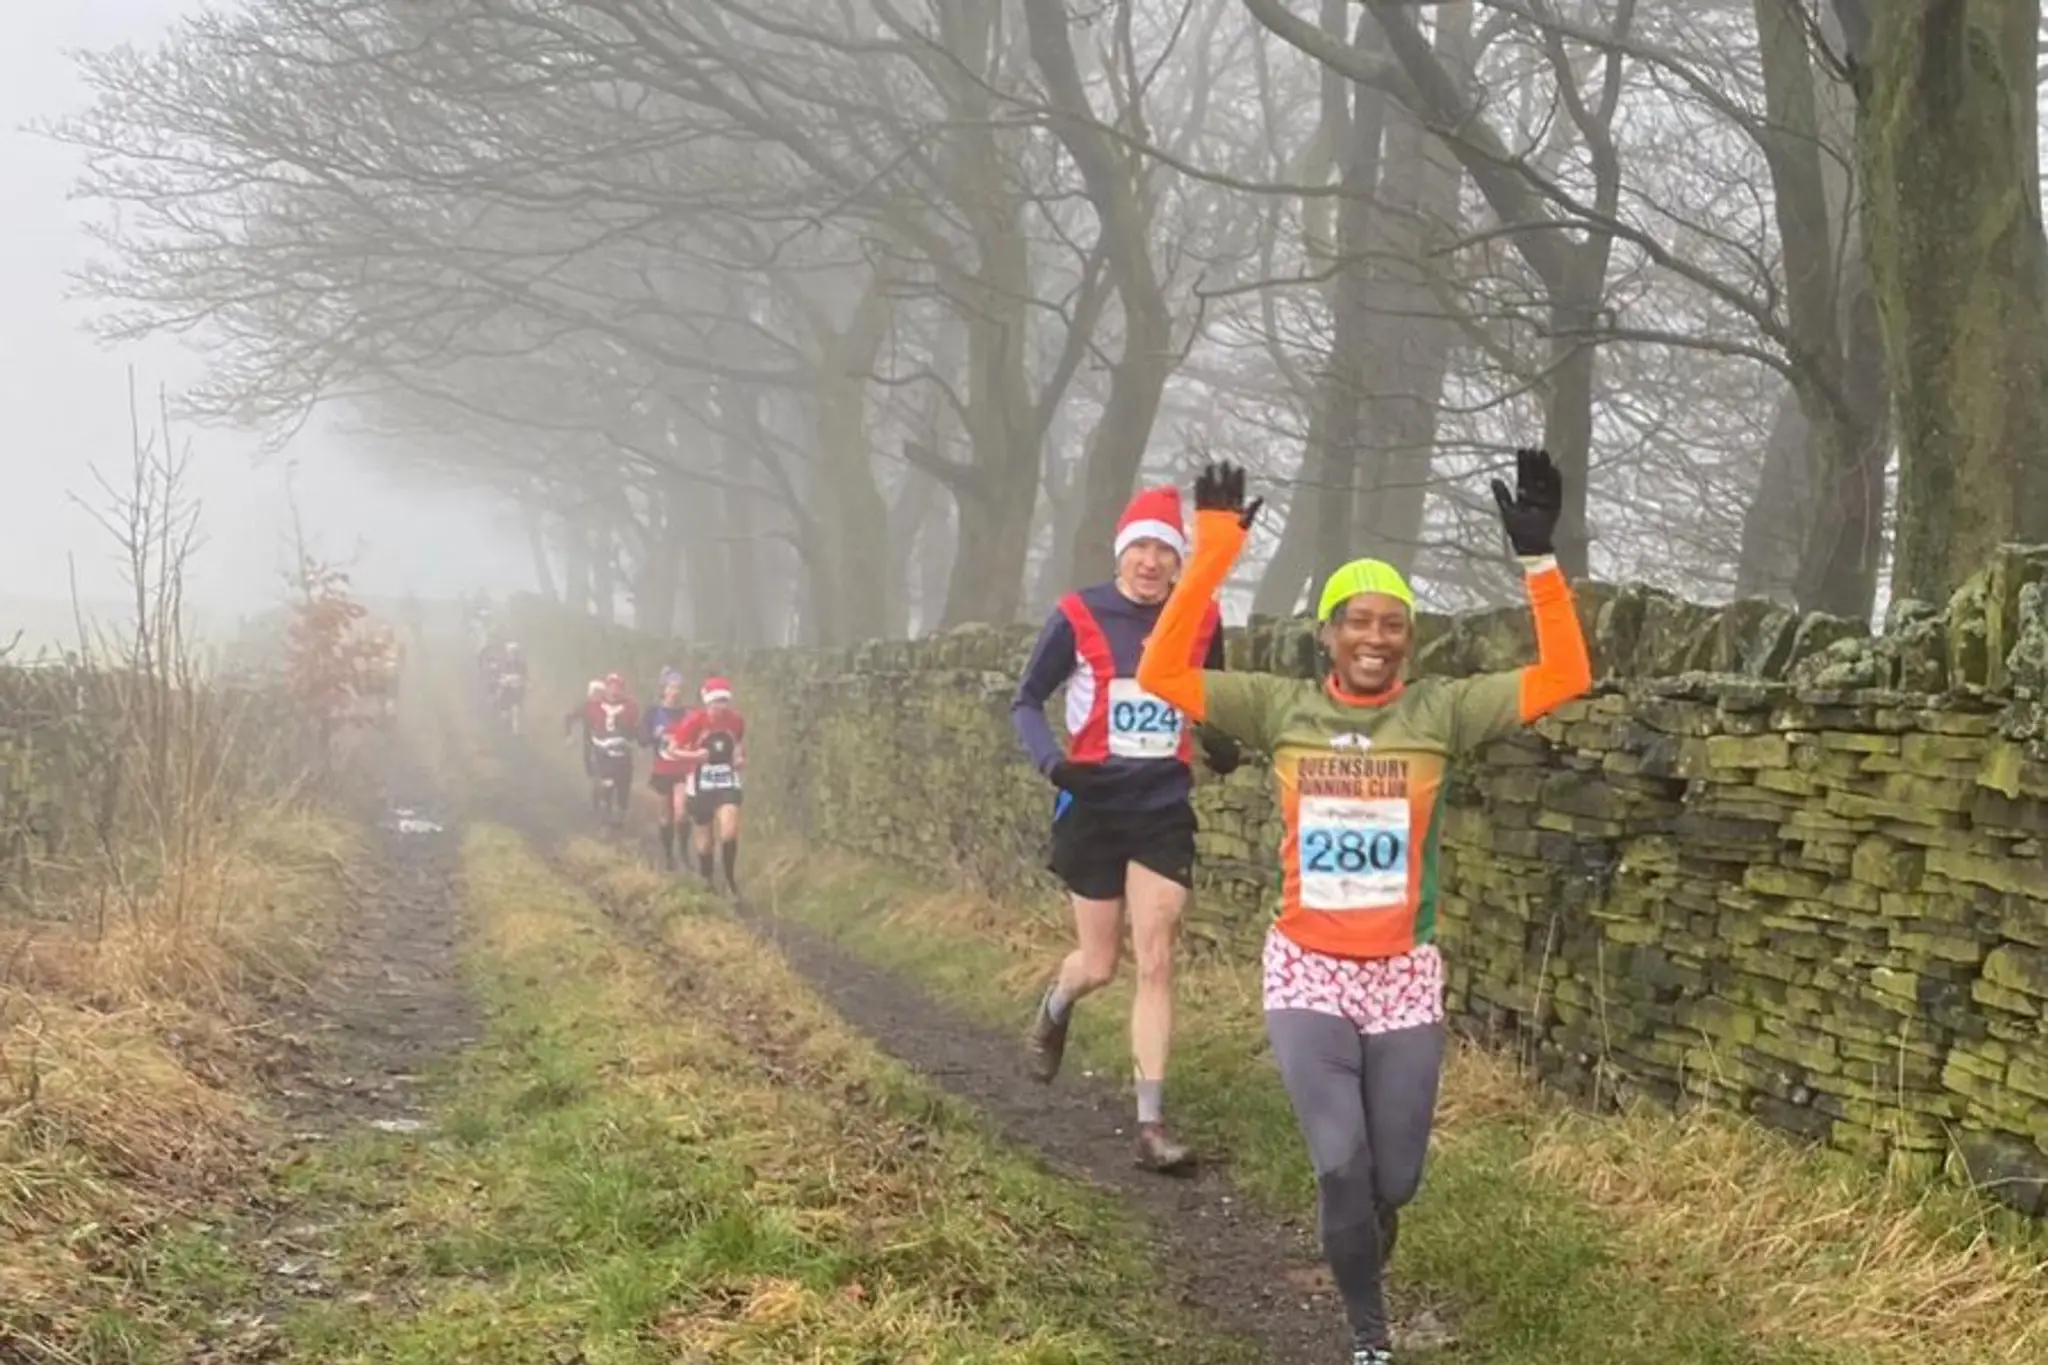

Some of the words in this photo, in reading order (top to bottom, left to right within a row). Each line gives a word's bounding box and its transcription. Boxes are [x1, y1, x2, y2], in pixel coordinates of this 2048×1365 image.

[1114, 700, 1178, 733] 024
[1298, 757, 1409, 778] QUEENSBURY
[1368, 779, 1407, 797] CLUB
[1305, 829, 1401, 873] 280
